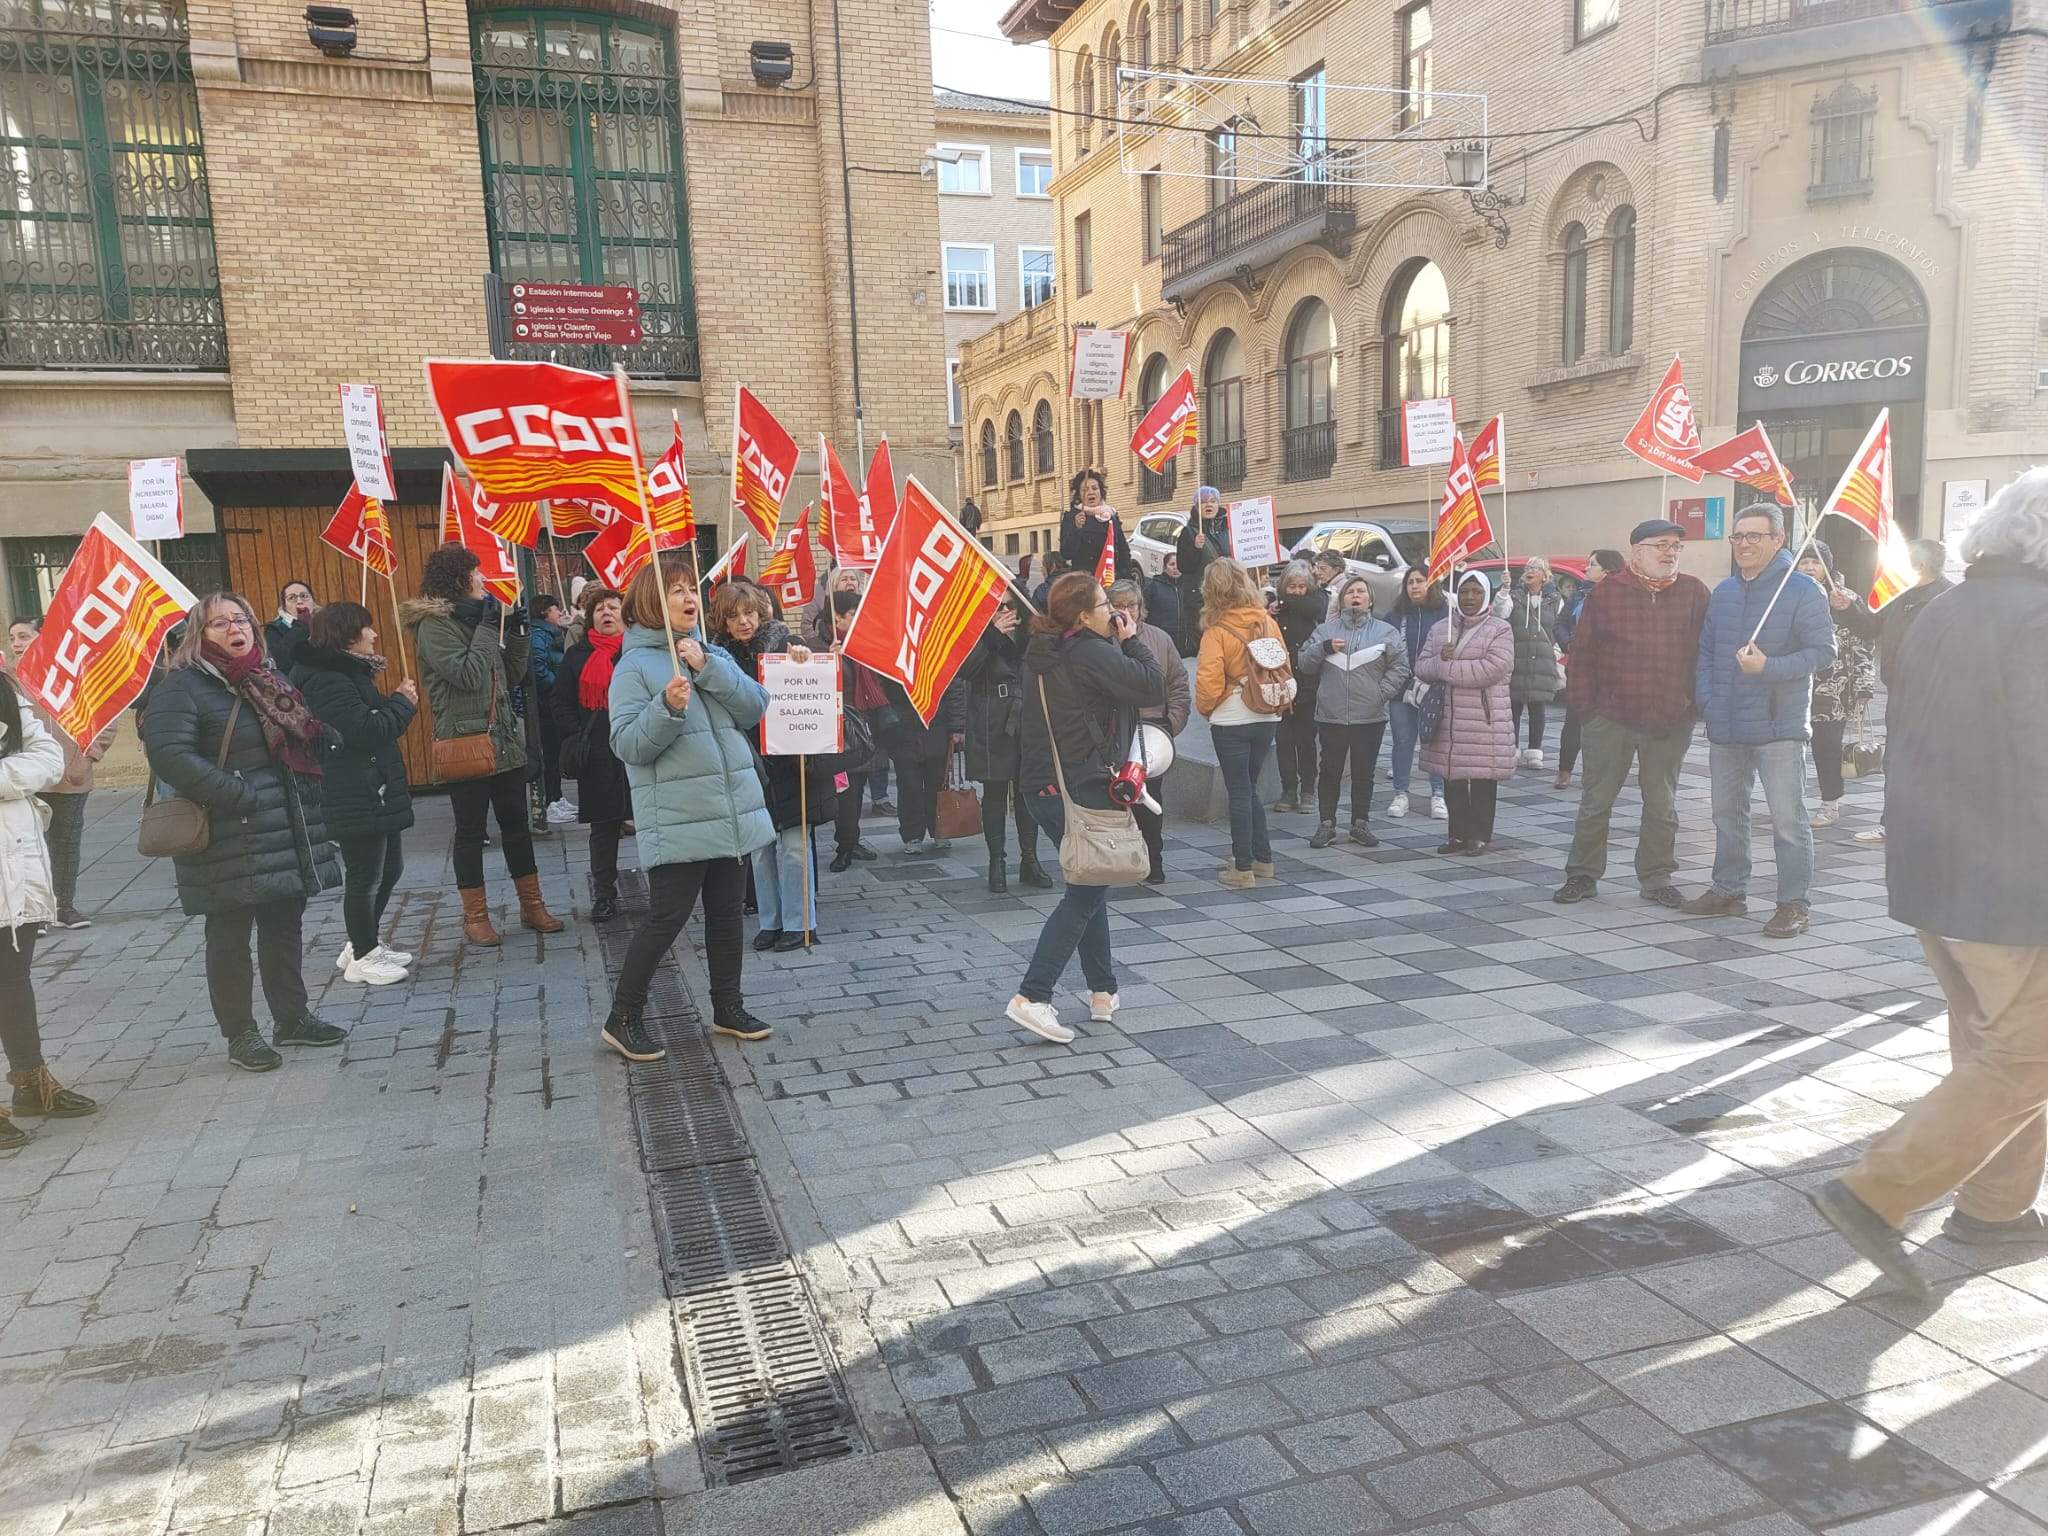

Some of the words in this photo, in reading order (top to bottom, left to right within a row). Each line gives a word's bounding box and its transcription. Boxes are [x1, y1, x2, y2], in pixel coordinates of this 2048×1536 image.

[528, 287, 562, 297] Estación
[563, 289, 604, 298] Intermodal
[530, 305, 554, 315] Iglesia
[556, 306, 566, 314] de
[567, 306, 589, 314] Santo
[591, 307, 625, 316] Domingo
[531, 322, 556, 332] Iglesia
[563, 323, 596, 331] Claustro
[543, 331, 559, 339] San
[561, 331, 583, 339] Pedro
[584, 331, 592, 339] el
[594, 332, 612, 341] Viejo
[145, 513, 165, 521] DIGNO
[895, 519, 967, 686] CCOO
[42, 561, 140, 712] CCOO
[784, 678, 803, 686] POR
[771, 692, 831, 701] INCREMENTO
[779, 708, 824, 716] SALARIAL
[788, 723, 818, 731] DIGNO
